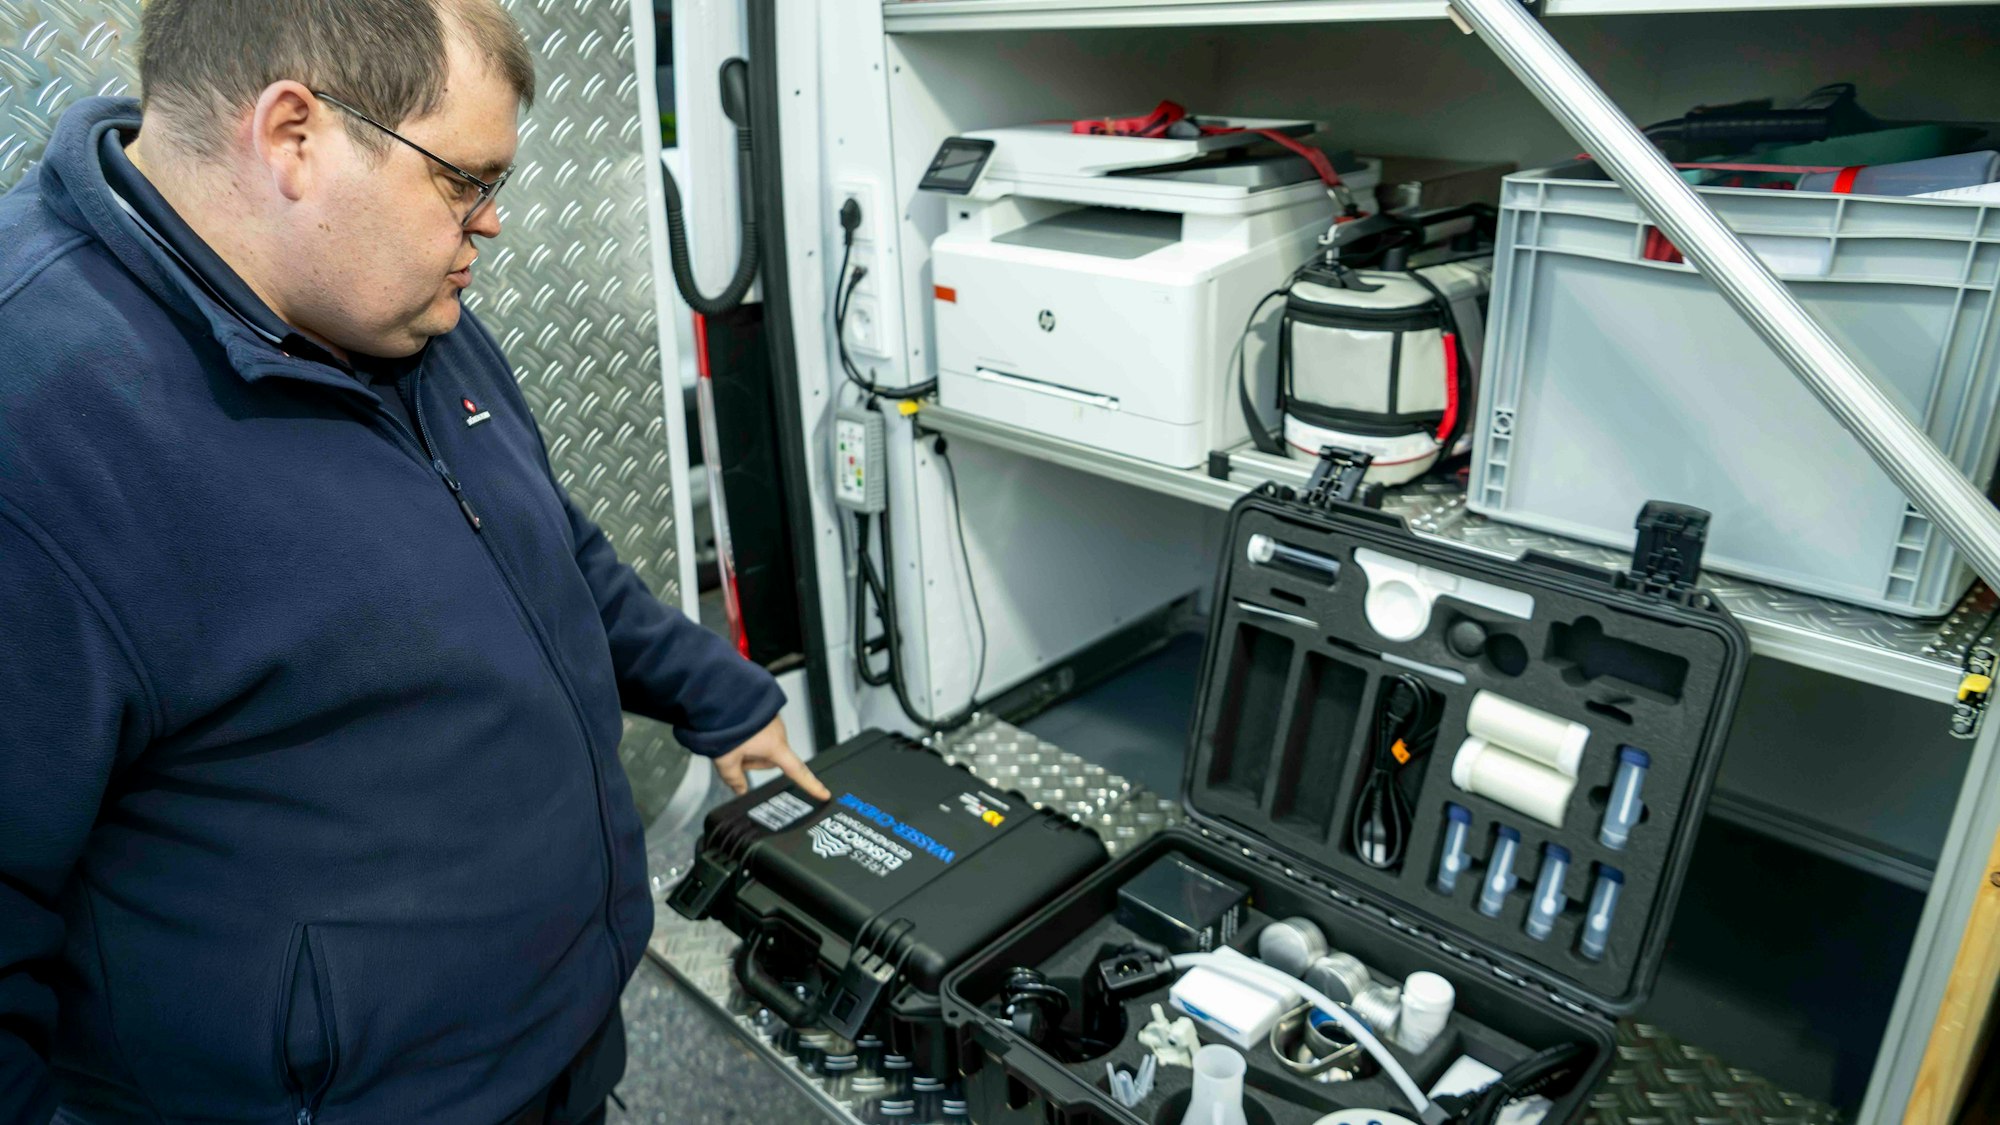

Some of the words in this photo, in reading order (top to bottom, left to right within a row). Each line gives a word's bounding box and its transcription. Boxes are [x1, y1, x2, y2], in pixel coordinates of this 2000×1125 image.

[1038, 309, 1056, 333] hp
[819, 817, 903, 871] EUSKIRCHEN
[838, 793, 956, 864] WASSER-CHEMIE
[850, 849, 889, 877] KREIS
